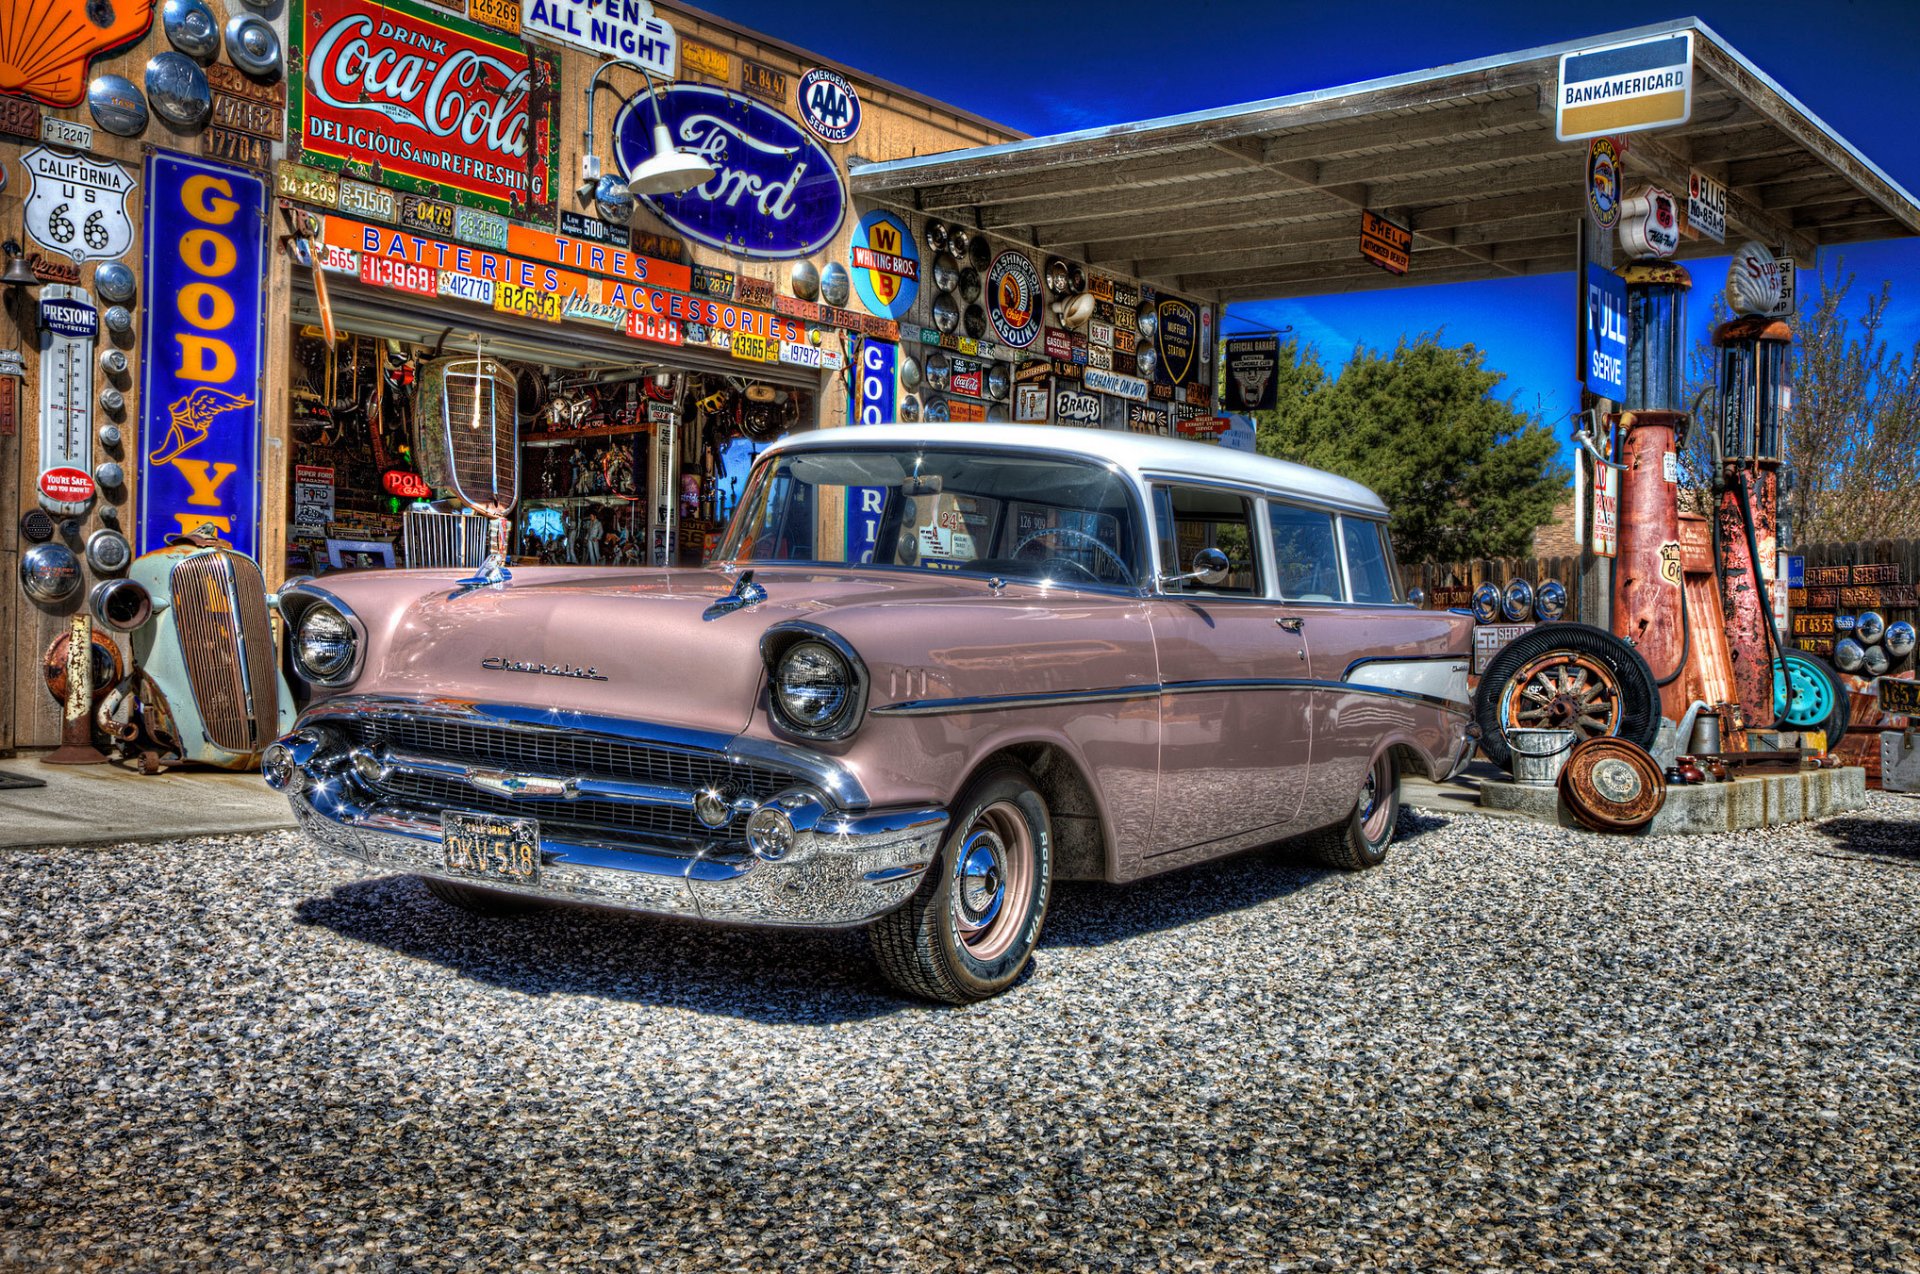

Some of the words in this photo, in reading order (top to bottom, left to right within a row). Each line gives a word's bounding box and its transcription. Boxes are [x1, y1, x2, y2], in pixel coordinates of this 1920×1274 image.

[571, 0, 639, 26] EN
[377, 20, 449, 57] DRINK
[530, 0, 581, 37] ALL
[591, 17, 671, 66] NIGHT
[308, 14, 531, 158] Coca-Cola
[807, 70, 855, 100] EMERGENCY
[1565, 70, 1684, 105] BANKAMERICARD
[810, 84, 849, 126] AAA
[807, 117, 848, 139] SERVICE
[309, 115, 412, 161] DELICIOUS
[413, 149, 440, 169] AND
[441, 151, 542, 196] REFRESHING
[1593, 141, 1612, 159] SANTA
[39, 157, 121, 190] CALIFORNIA
[1590, 188, 1619, 223] TRAILWAYS
[1700, 176, 1725, 216] ELLIS
[48, 202, 109, 250] 66
[417, 202, 452, 227] 0479
[562, 222, 583, 234] Requires
[583, 218, 603, 239] 500
[875, 226, 895, 251] W
[1370, 220, 1404, 247] SHELL
[363, 225, 559, 292] BATTERIES
[555, 238, 649, 279] TIRES
[856, 247, 892, 271] WHITING
[892, 256, 915, 276] BROS.
[879, 273, 894, 297] B
[991, 254, 1040, 295] WASHINGTON
[43, 303, 97, 327] PRESTONE
[563, 287, 627, 332] Liberty
[611, 283, 797, 342] ACCESSORIES
[1005, 307, 1029, 327] Chief
[1162, 303, 1193, 326] OFFICIAL
[1588, 284, 1627, 346] FULL
[49, 321, 91, 334] ANTI-FREEZE
[992, 308, 1038, 344] GASOLINE
[733, 334, 764, 360] 43365
[1046, 336, 1071, 350] GASOLINE
[1167, 344, 1186, 358] STATION
[1230, 341, 1253, 353] OFFICIAL
[1254, 340, 1276, 352] GARAGE
[954, 359, 965, 367] GAS
[1063, 363, 1081, 378] SMITH
[1592, 348, 1622, 387] SERVE
[1085, 371, 1119, 393] MECHANIC
[1119, 379, 1130, 395] ON
[1059, 393, 1099, 419] BRAKES
[1141, 409, 1156, 424] NO
[297, 470, 316, 478] SUPER
[403, 486, 427, 496] GAS
[941, 512, 957, 531] 24
[1433, 592, 1449, 605] SOFT
[1450, 590, 1472, 604] SANDY
[481, 657, 609, 682] Chevrolet
[465, 823, 511, 836] CALIFORNIA
[494, 842, 532, 876] 518
[1040, 831, 1049, 907] Radial
[1025, 914, 1042, 945] T/A
